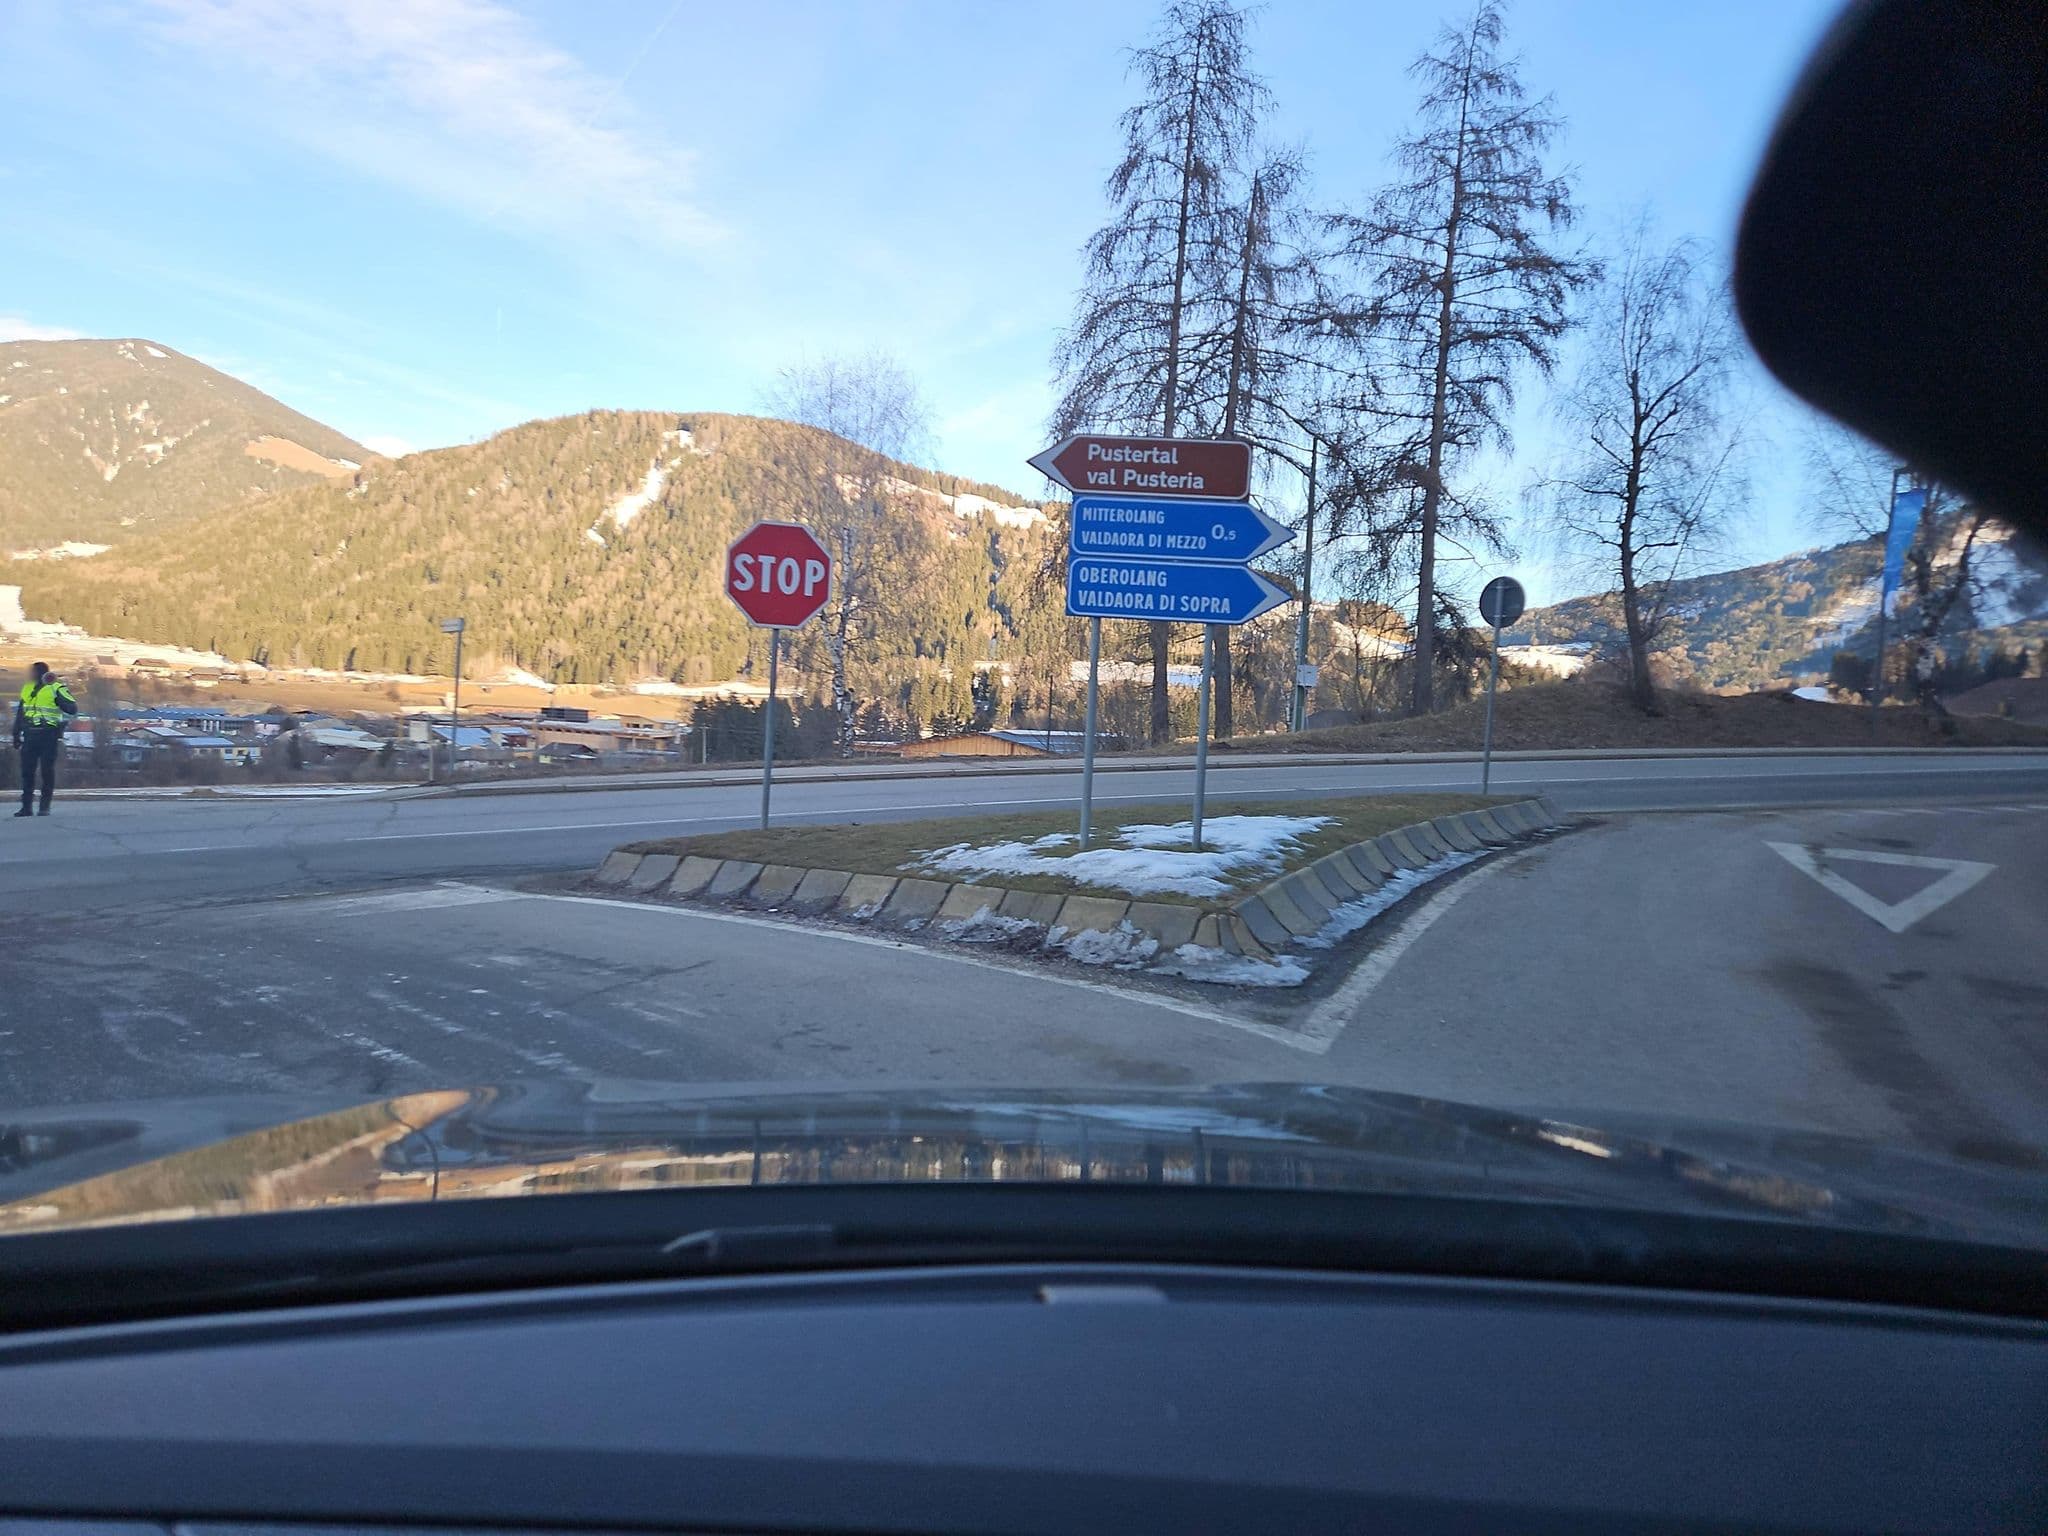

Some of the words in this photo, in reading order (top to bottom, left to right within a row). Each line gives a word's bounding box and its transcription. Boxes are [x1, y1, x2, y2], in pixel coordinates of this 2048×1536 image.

[1088, 443, 1178, 465] Pustertal
[1087, 470, 1115, 485] val
[1123, 469, 1204, 490] Pusteria
[1082, 507, 1165, 525] MITTEROLANG
[1081, 530, 1145, 547] VALDAORA
[1148, 533, 1161, 548] DI
[1166, 534, 1206, 550] MEZZO
[733, 553, 825, 597] STOP
[1079, 567, 1167, 587] OBEROLANG
[1078, 590, 1154, 610] VALDAORA
[1159, 593, 1176, 611] DI
[1180, 595, 1231, 614] SOPRA
